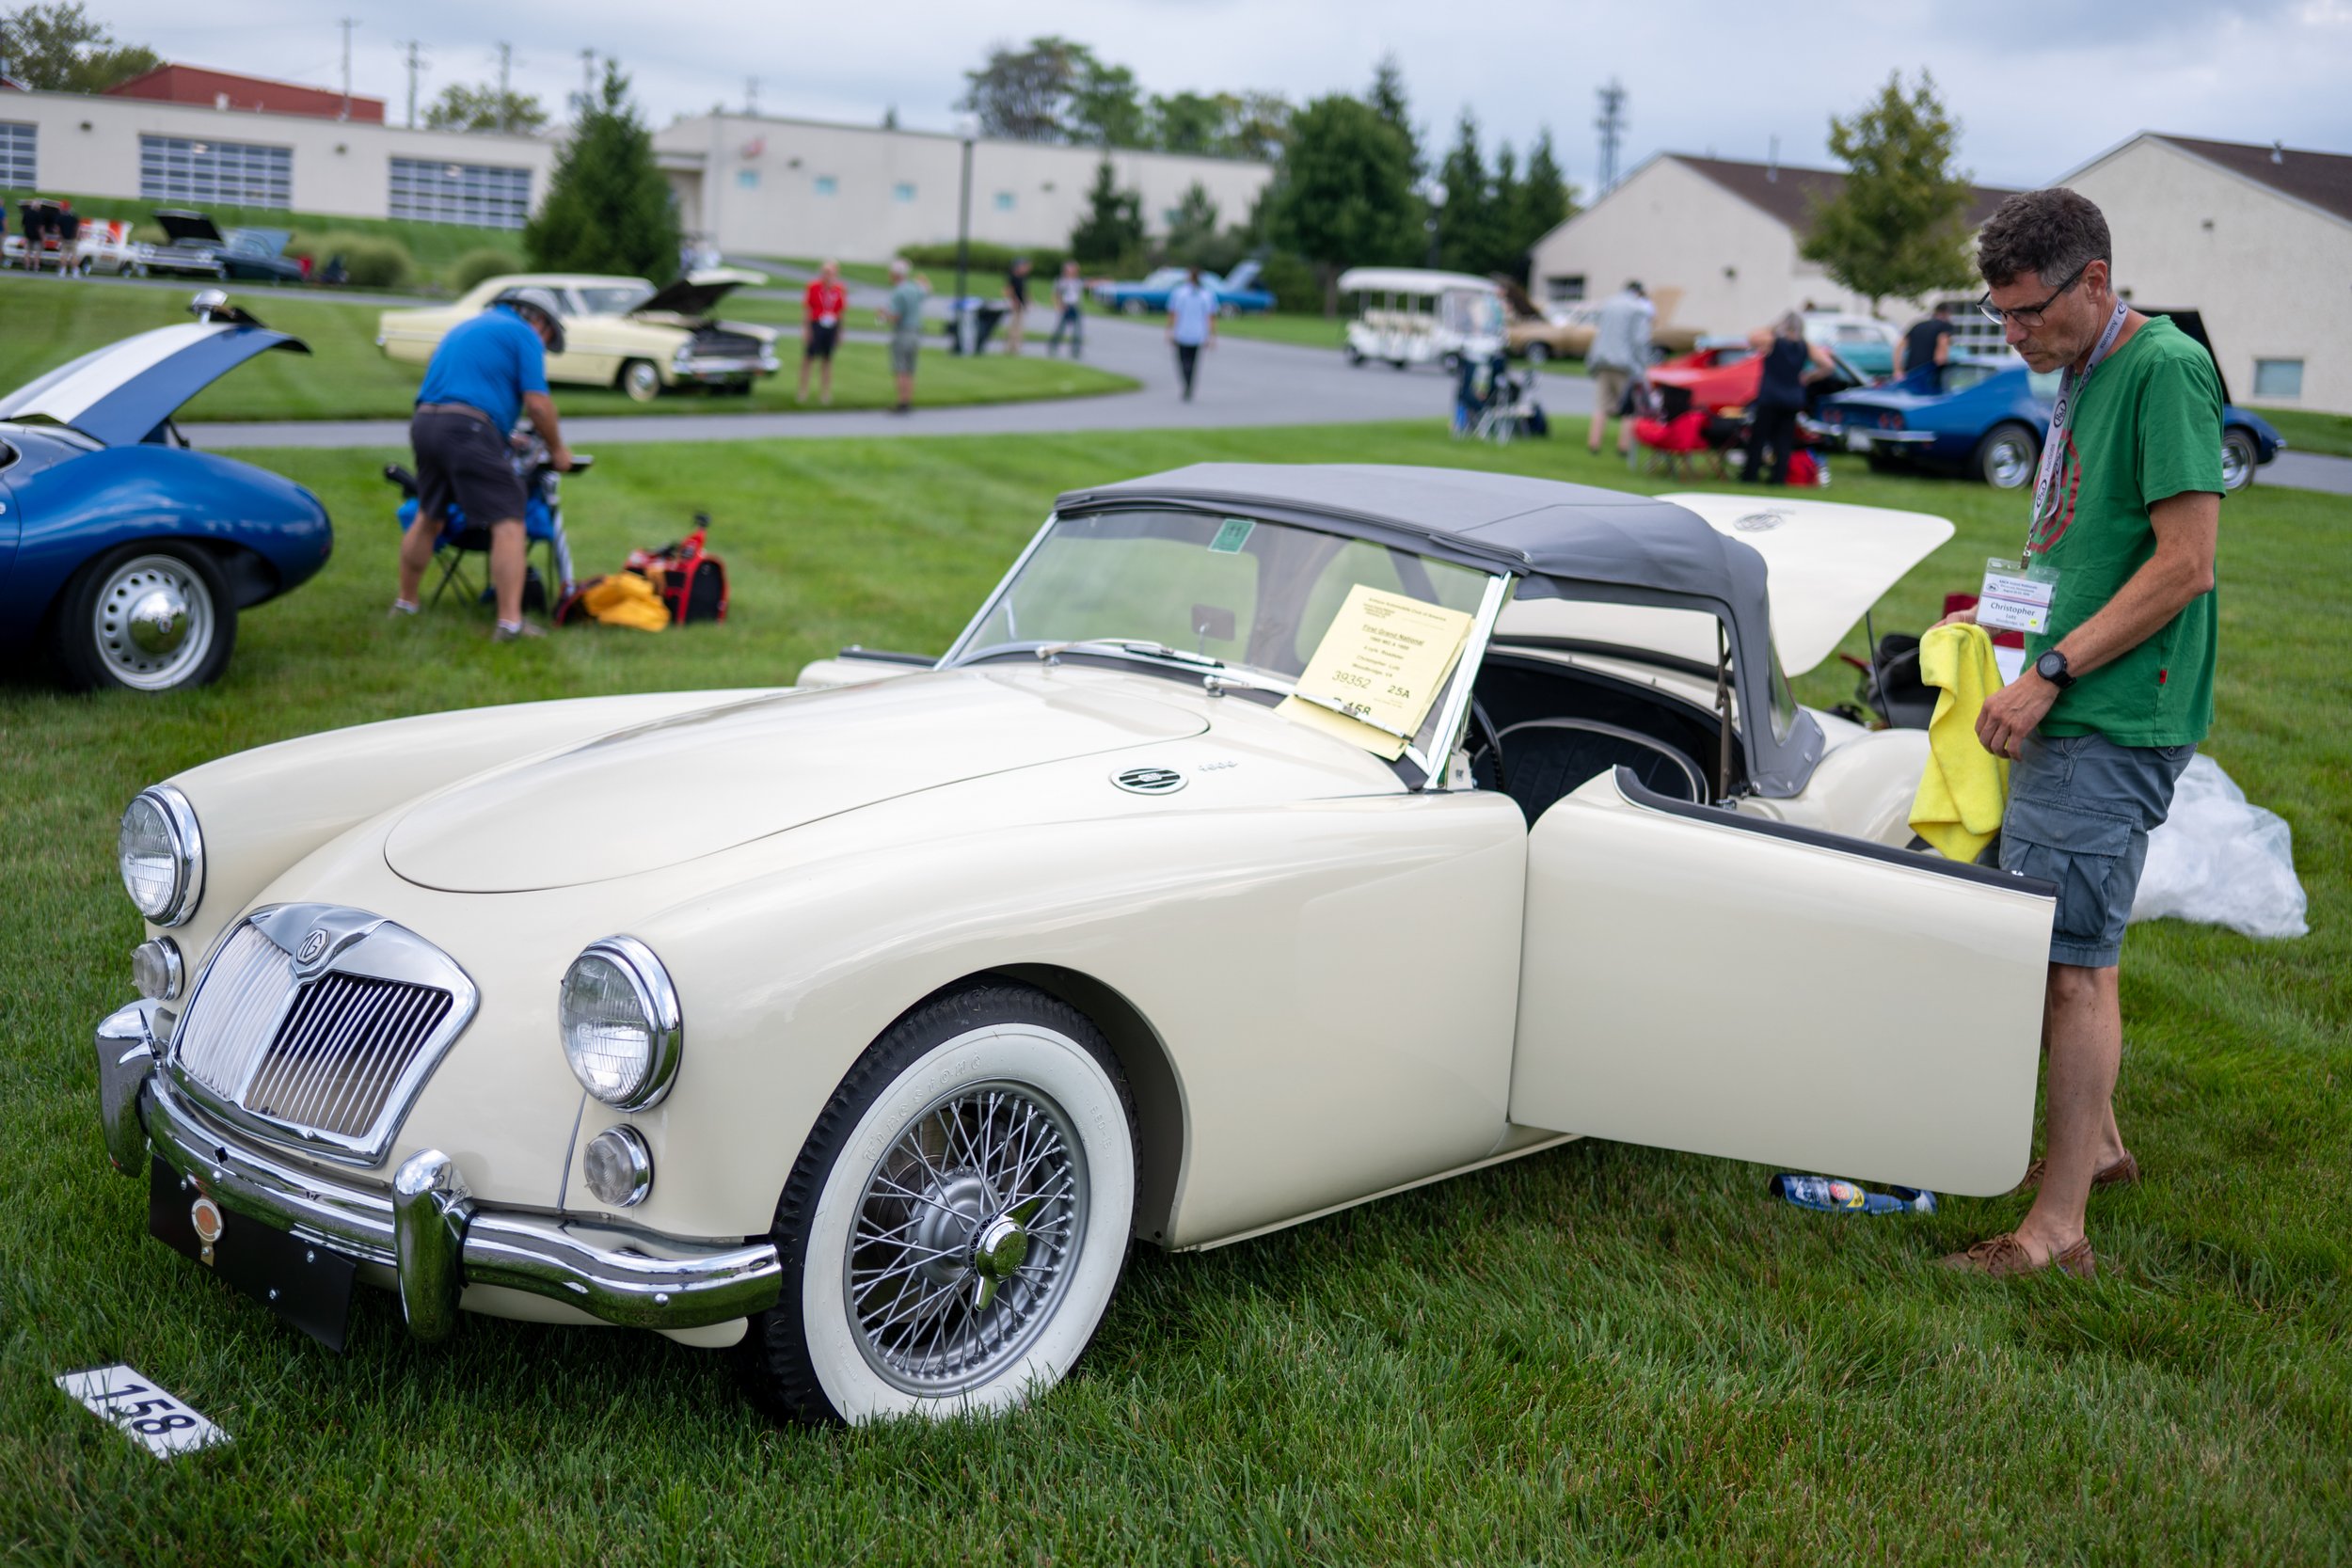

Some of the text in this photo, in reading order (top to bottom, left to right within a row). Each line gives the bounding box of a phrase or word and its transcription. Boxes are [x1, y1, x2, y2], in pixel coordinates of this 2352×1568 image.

[1990, 602, 2036, 616] Christopher
[1331, 670, 1409, 699] 39352 25A
[90, 1384, 197, 1435] 158
